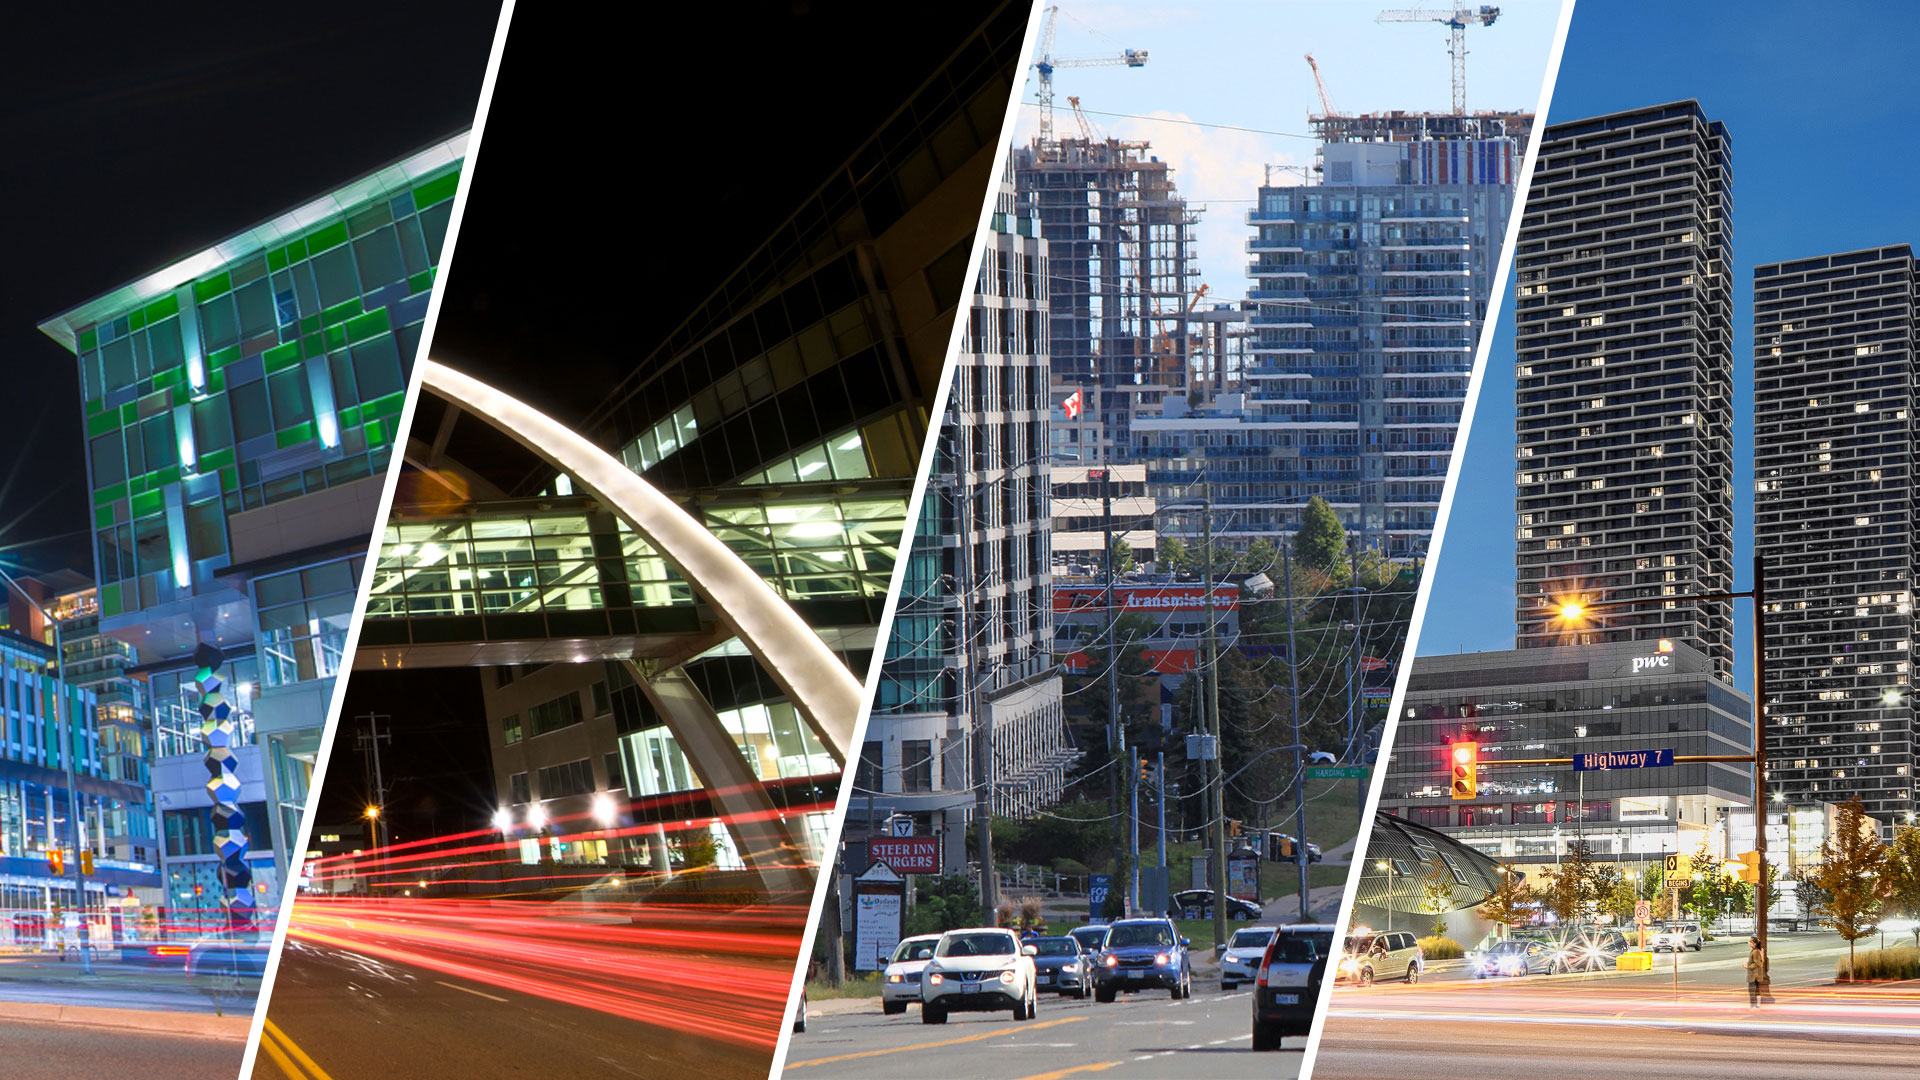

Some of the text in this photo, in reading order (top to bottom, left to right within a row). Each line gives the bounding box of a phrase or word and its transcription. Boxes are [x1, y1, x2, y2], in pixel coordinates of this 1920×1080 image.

[1128, 593, 1231, 608] transmisson
[1632, 656, 1669, 673] pwc
[1584, 750, 1662, 770] Highway 7
[1315, 769, 1345, 777] HARDING
[872, 844, 935, 855] STEER INN
[883, 856, 933, 867] URGERS
[1091, 887, 1108, 896] FOR
